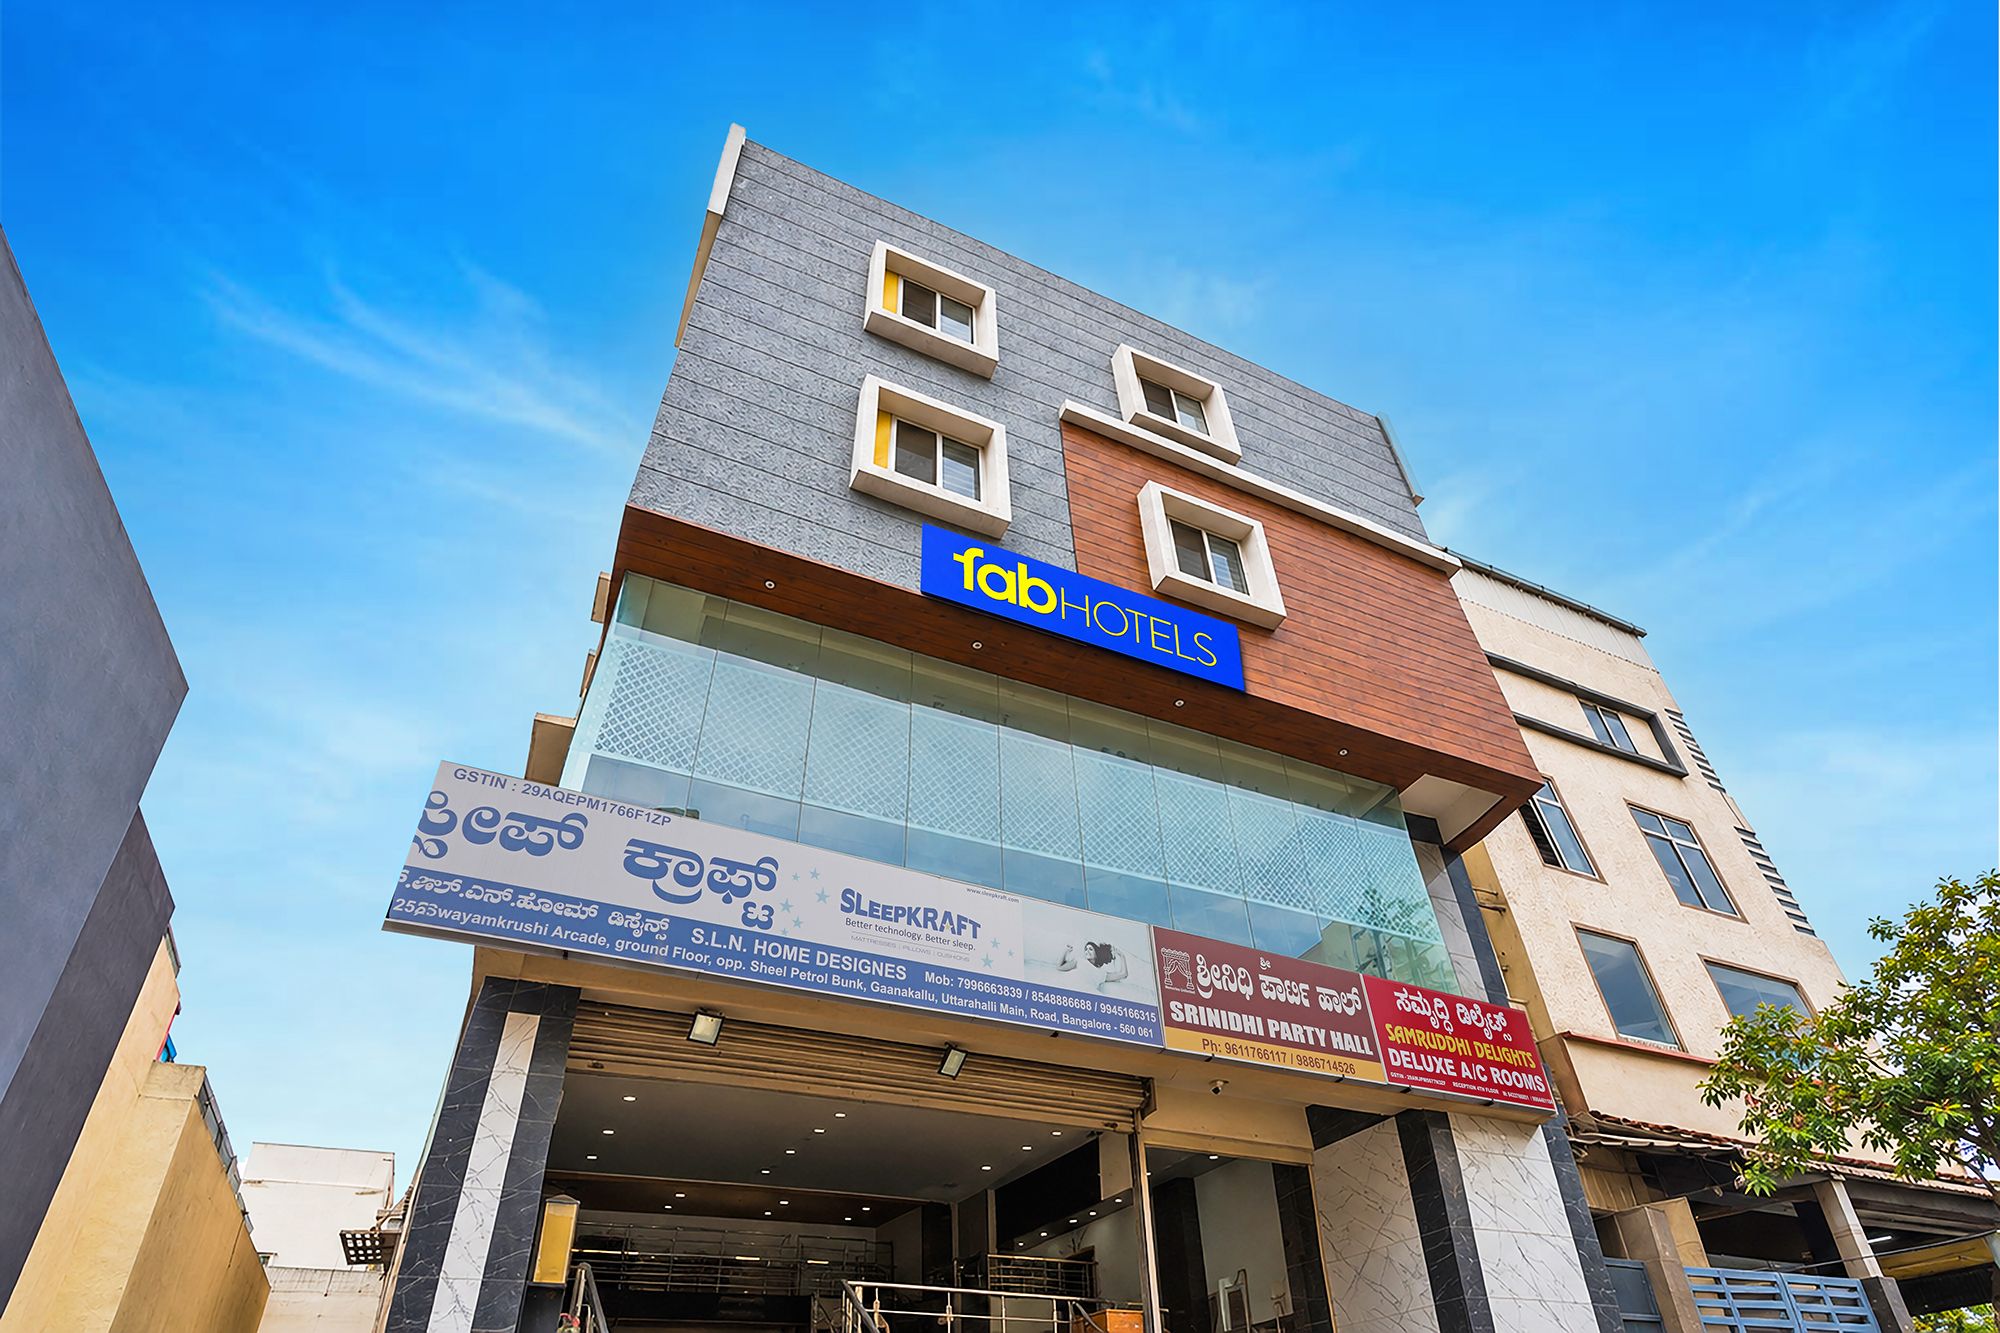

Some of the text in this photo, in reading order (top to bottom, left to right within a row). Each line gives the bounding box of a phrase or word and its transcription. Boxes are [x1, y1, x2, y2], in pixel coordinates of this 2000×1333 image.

[454, 768, 508, 789] GSTIN
[521, 783, 671, 826] 29AQEPM1766F1ZP
[690, 927, 907, 981] S.L.N. HOME DESIGNES
[845, 917, 976, 952] Better technology. Better sleep.
[851, 935, 897, 949] MATTRESSES
[902, 944, 932, 956] PILLOWS
[551, 925, 610, 948] Arcade,
[615, 938, 669, 957] ground
[672, 946, 712, 966] Floor,
[716, 956, 746, 972] opp.
[750, 960, 787, 977] Sheel
[790, 967, 828, 984] Petrol
[832, 974, 867, 992] Bunk,
[870, 981, 938, 1004] Gaanakallu,
[941, 993, 997, 1012] Uttarahalli
[1000, 1003, 1027, 1019] Main,
[1030, 1008, 1060, 1024] Road,
[1062, 1013, 1111, 1030] Bangalore
[1120, 1024, 1136, 1035] 560
[1137, 1026, 1154, 1038] 061
[925, 971, 954, 987] Mob:
[957, 977, 1023, 999] 7996663839
[1031, 990, 1092, 1011] 8548886688
[1100, 1003, 1157, 1022] 9945166315
[1169, 1000, 1374, 1056] SRINIDHI PARTY HALL
[1385, 1023, 1536, 1069] SAMRUDDHI DELIGHTS
[1201, 1038, 1222, 1053] Ph:
[1224, 1042, 1287, 1063] 9611766117
[1296, 1054, 1356, 1075] 9886714526
[1387, 1048, 1546, 1093] DELUXE A/C ROOMS
